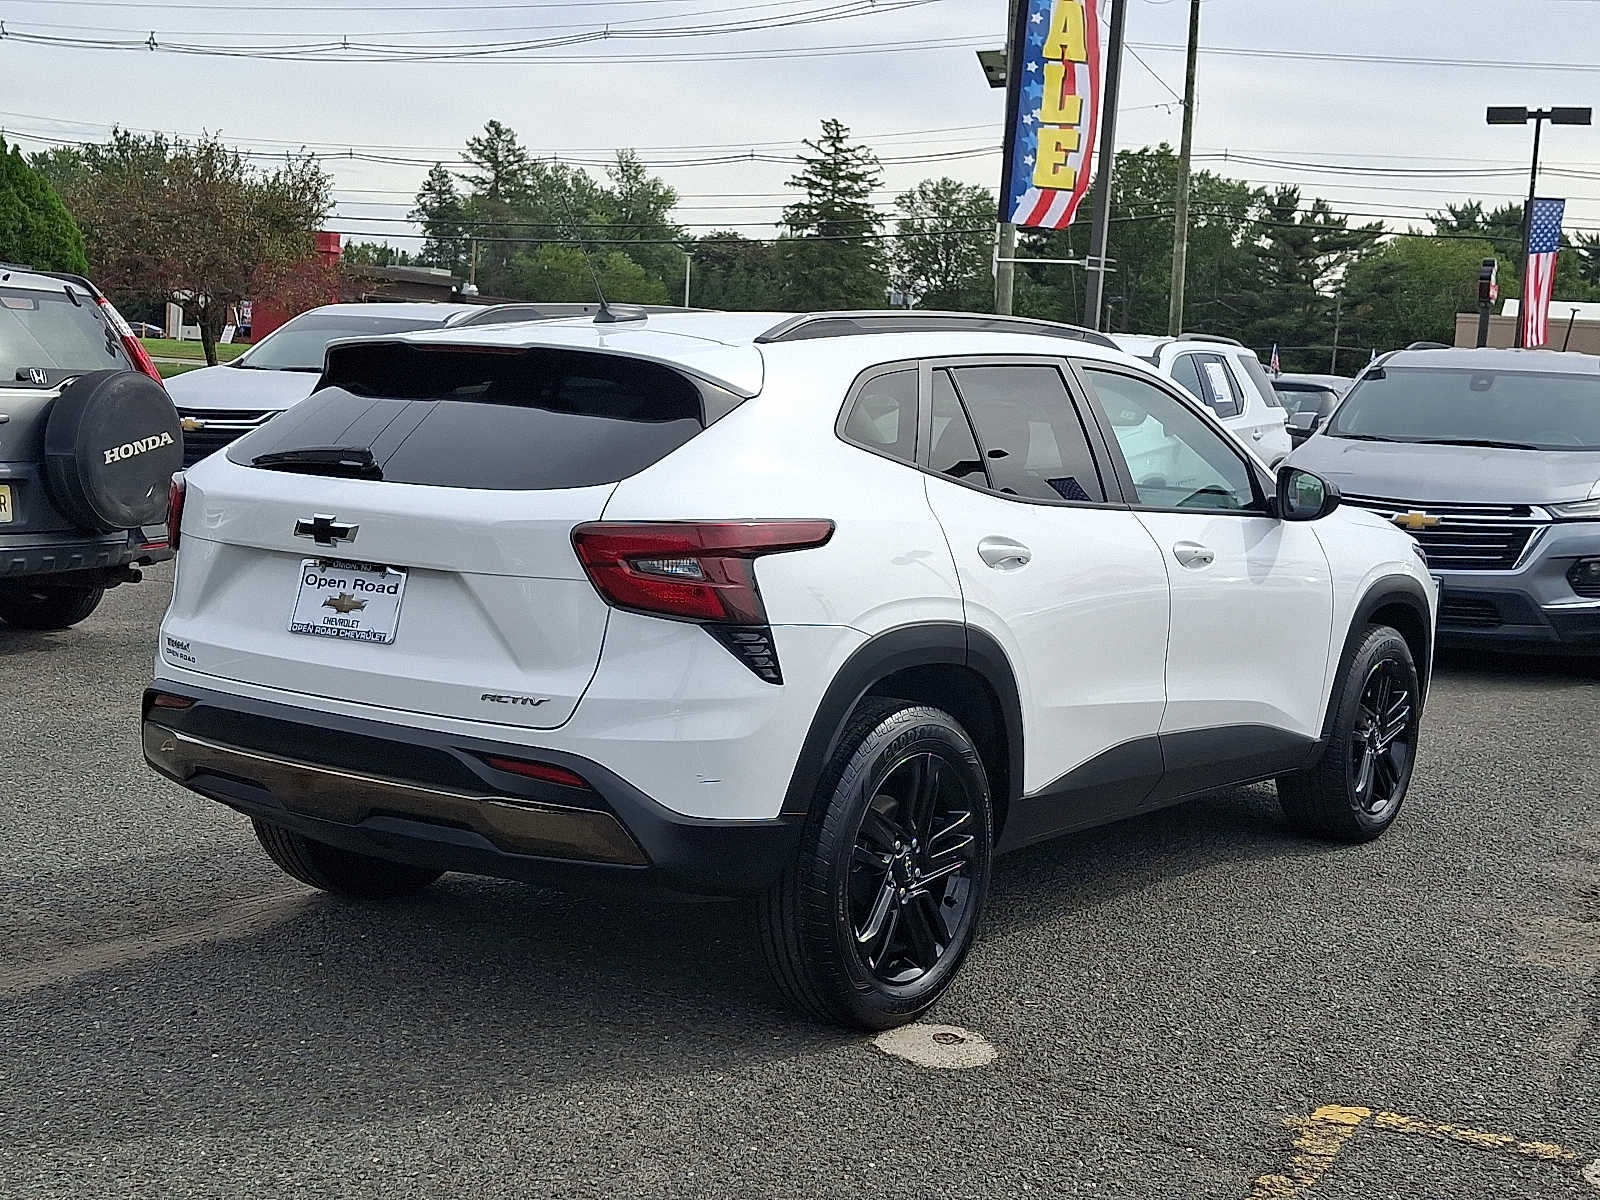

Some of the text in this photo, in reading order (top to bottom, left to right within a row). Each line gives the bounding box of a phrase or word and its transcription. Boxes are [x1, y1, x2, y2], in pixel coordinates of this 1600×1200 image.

[103, 431, 175, 465] HONDA
[305, 573, 400, 595] Open Road
[322, 616, 361, 629] CHEVROLET
[291, 622, 387, 642] OPEN ROAD CHEVROLET
[179, 653, 196, 664] ROAD
[480, 693, 551, 707] ACTIV
